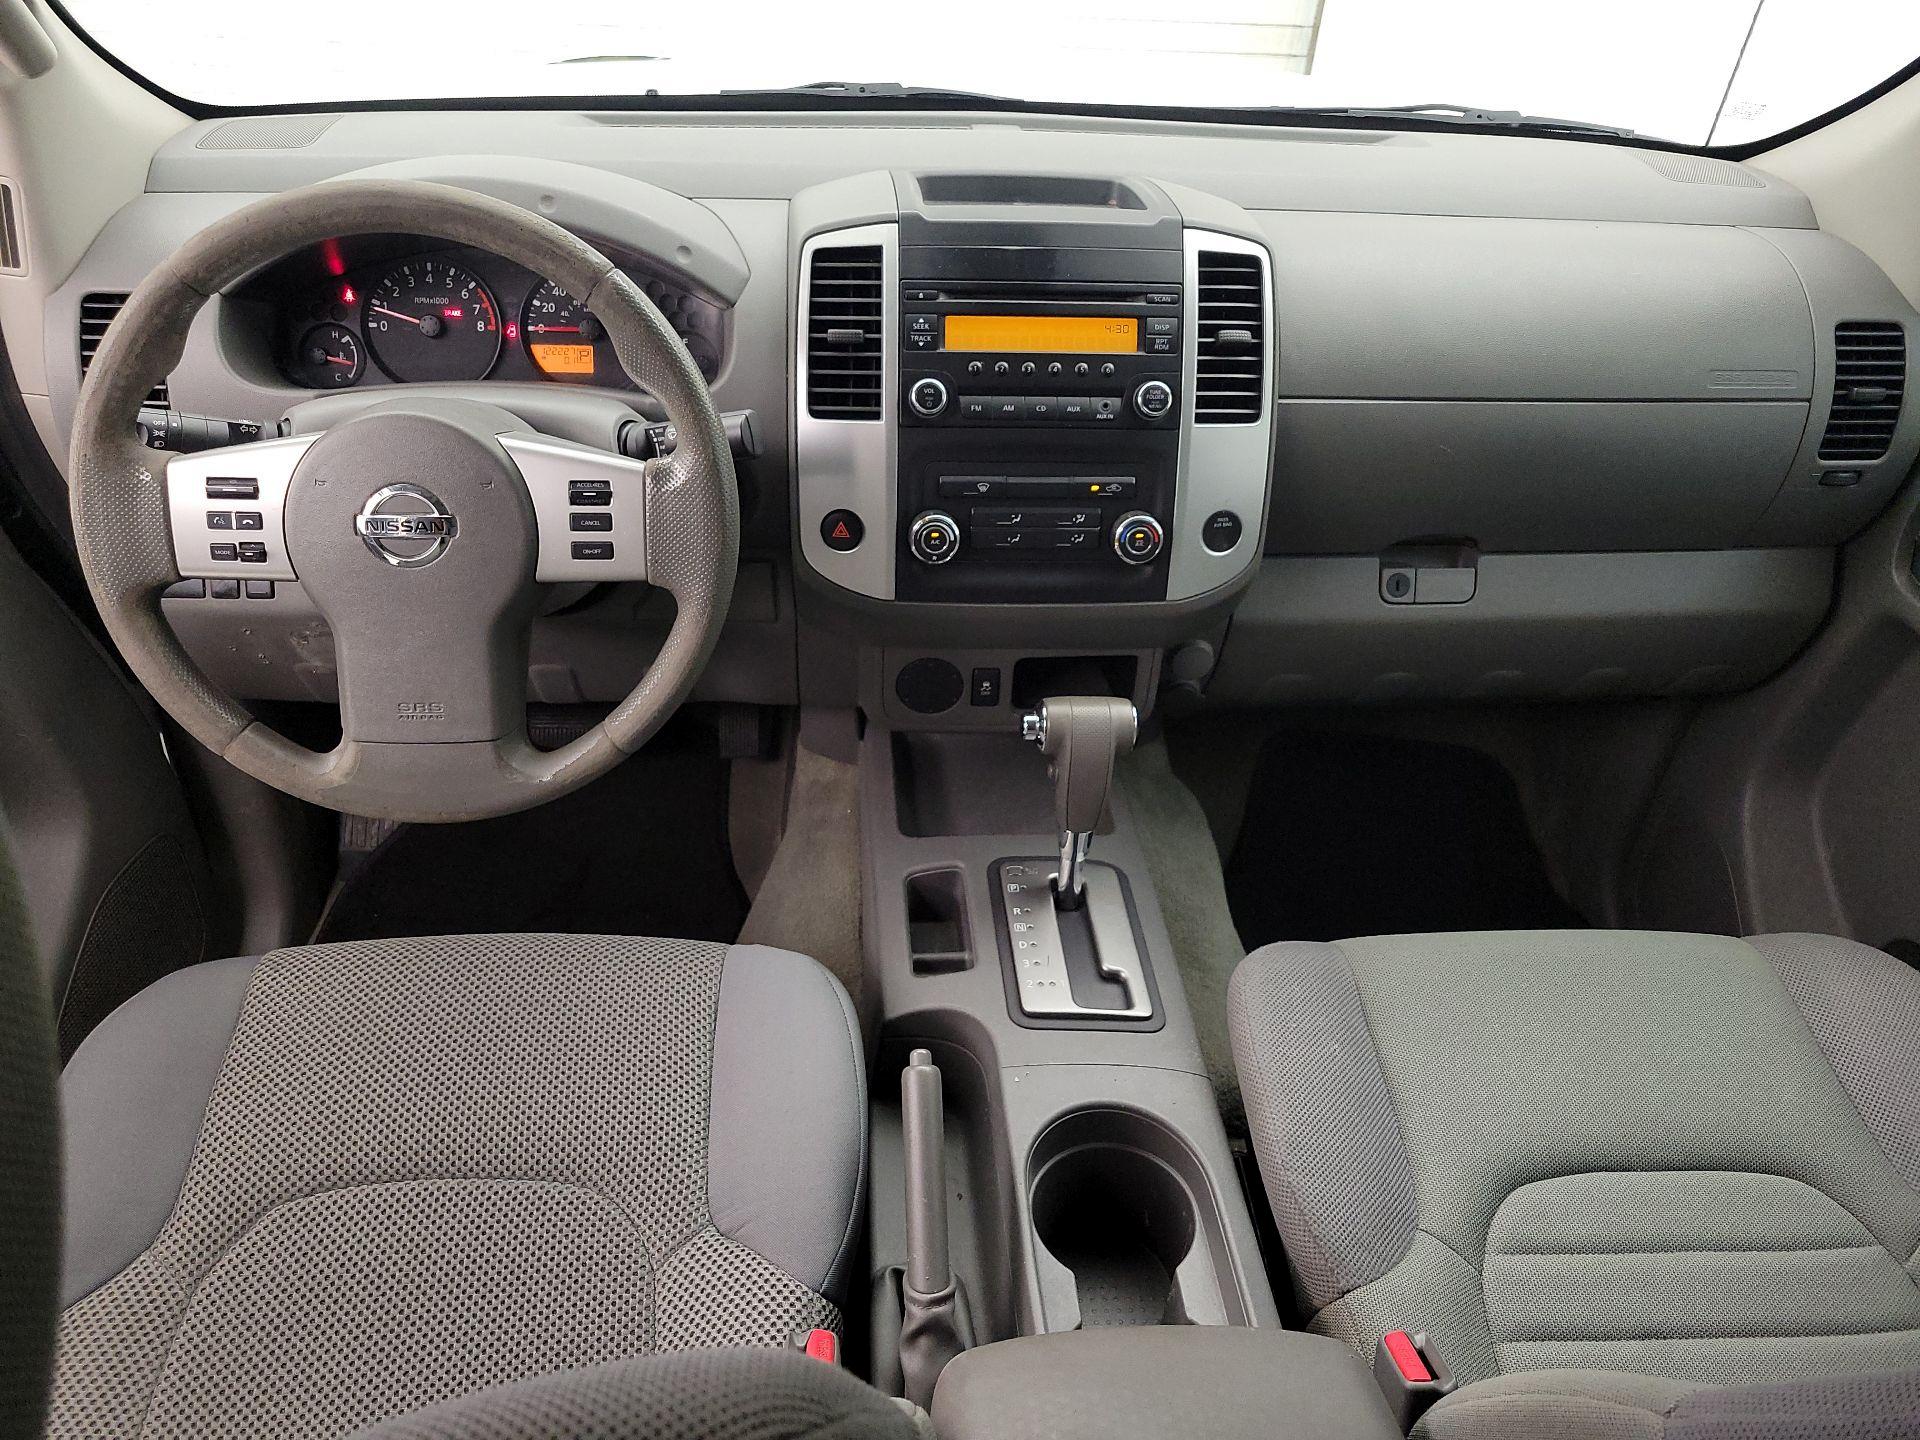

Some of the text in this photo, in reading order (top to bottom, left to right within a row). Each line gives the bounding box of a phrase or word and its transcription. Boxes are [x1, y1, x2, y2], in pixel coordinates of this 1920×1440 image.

[408, 276, 414, 287] 3
[426, 274, 432, 284] 4
[446, 278, 453, 288] 5
[392, 286, 400, 296] 2
[462, 288, 469, 299] 6
[472, 304, 480, 315] 7
[542, 302, 556, 312] 20
[380, 320, 388, 332] 0
[477, 321, 485, 332] 8
[1104, 324, 1130, 334] 4:30
[332, 330, 339, 339] H
[366, 520, 445, 533] NISSAN
[398, 702, 444, 713] SRS
